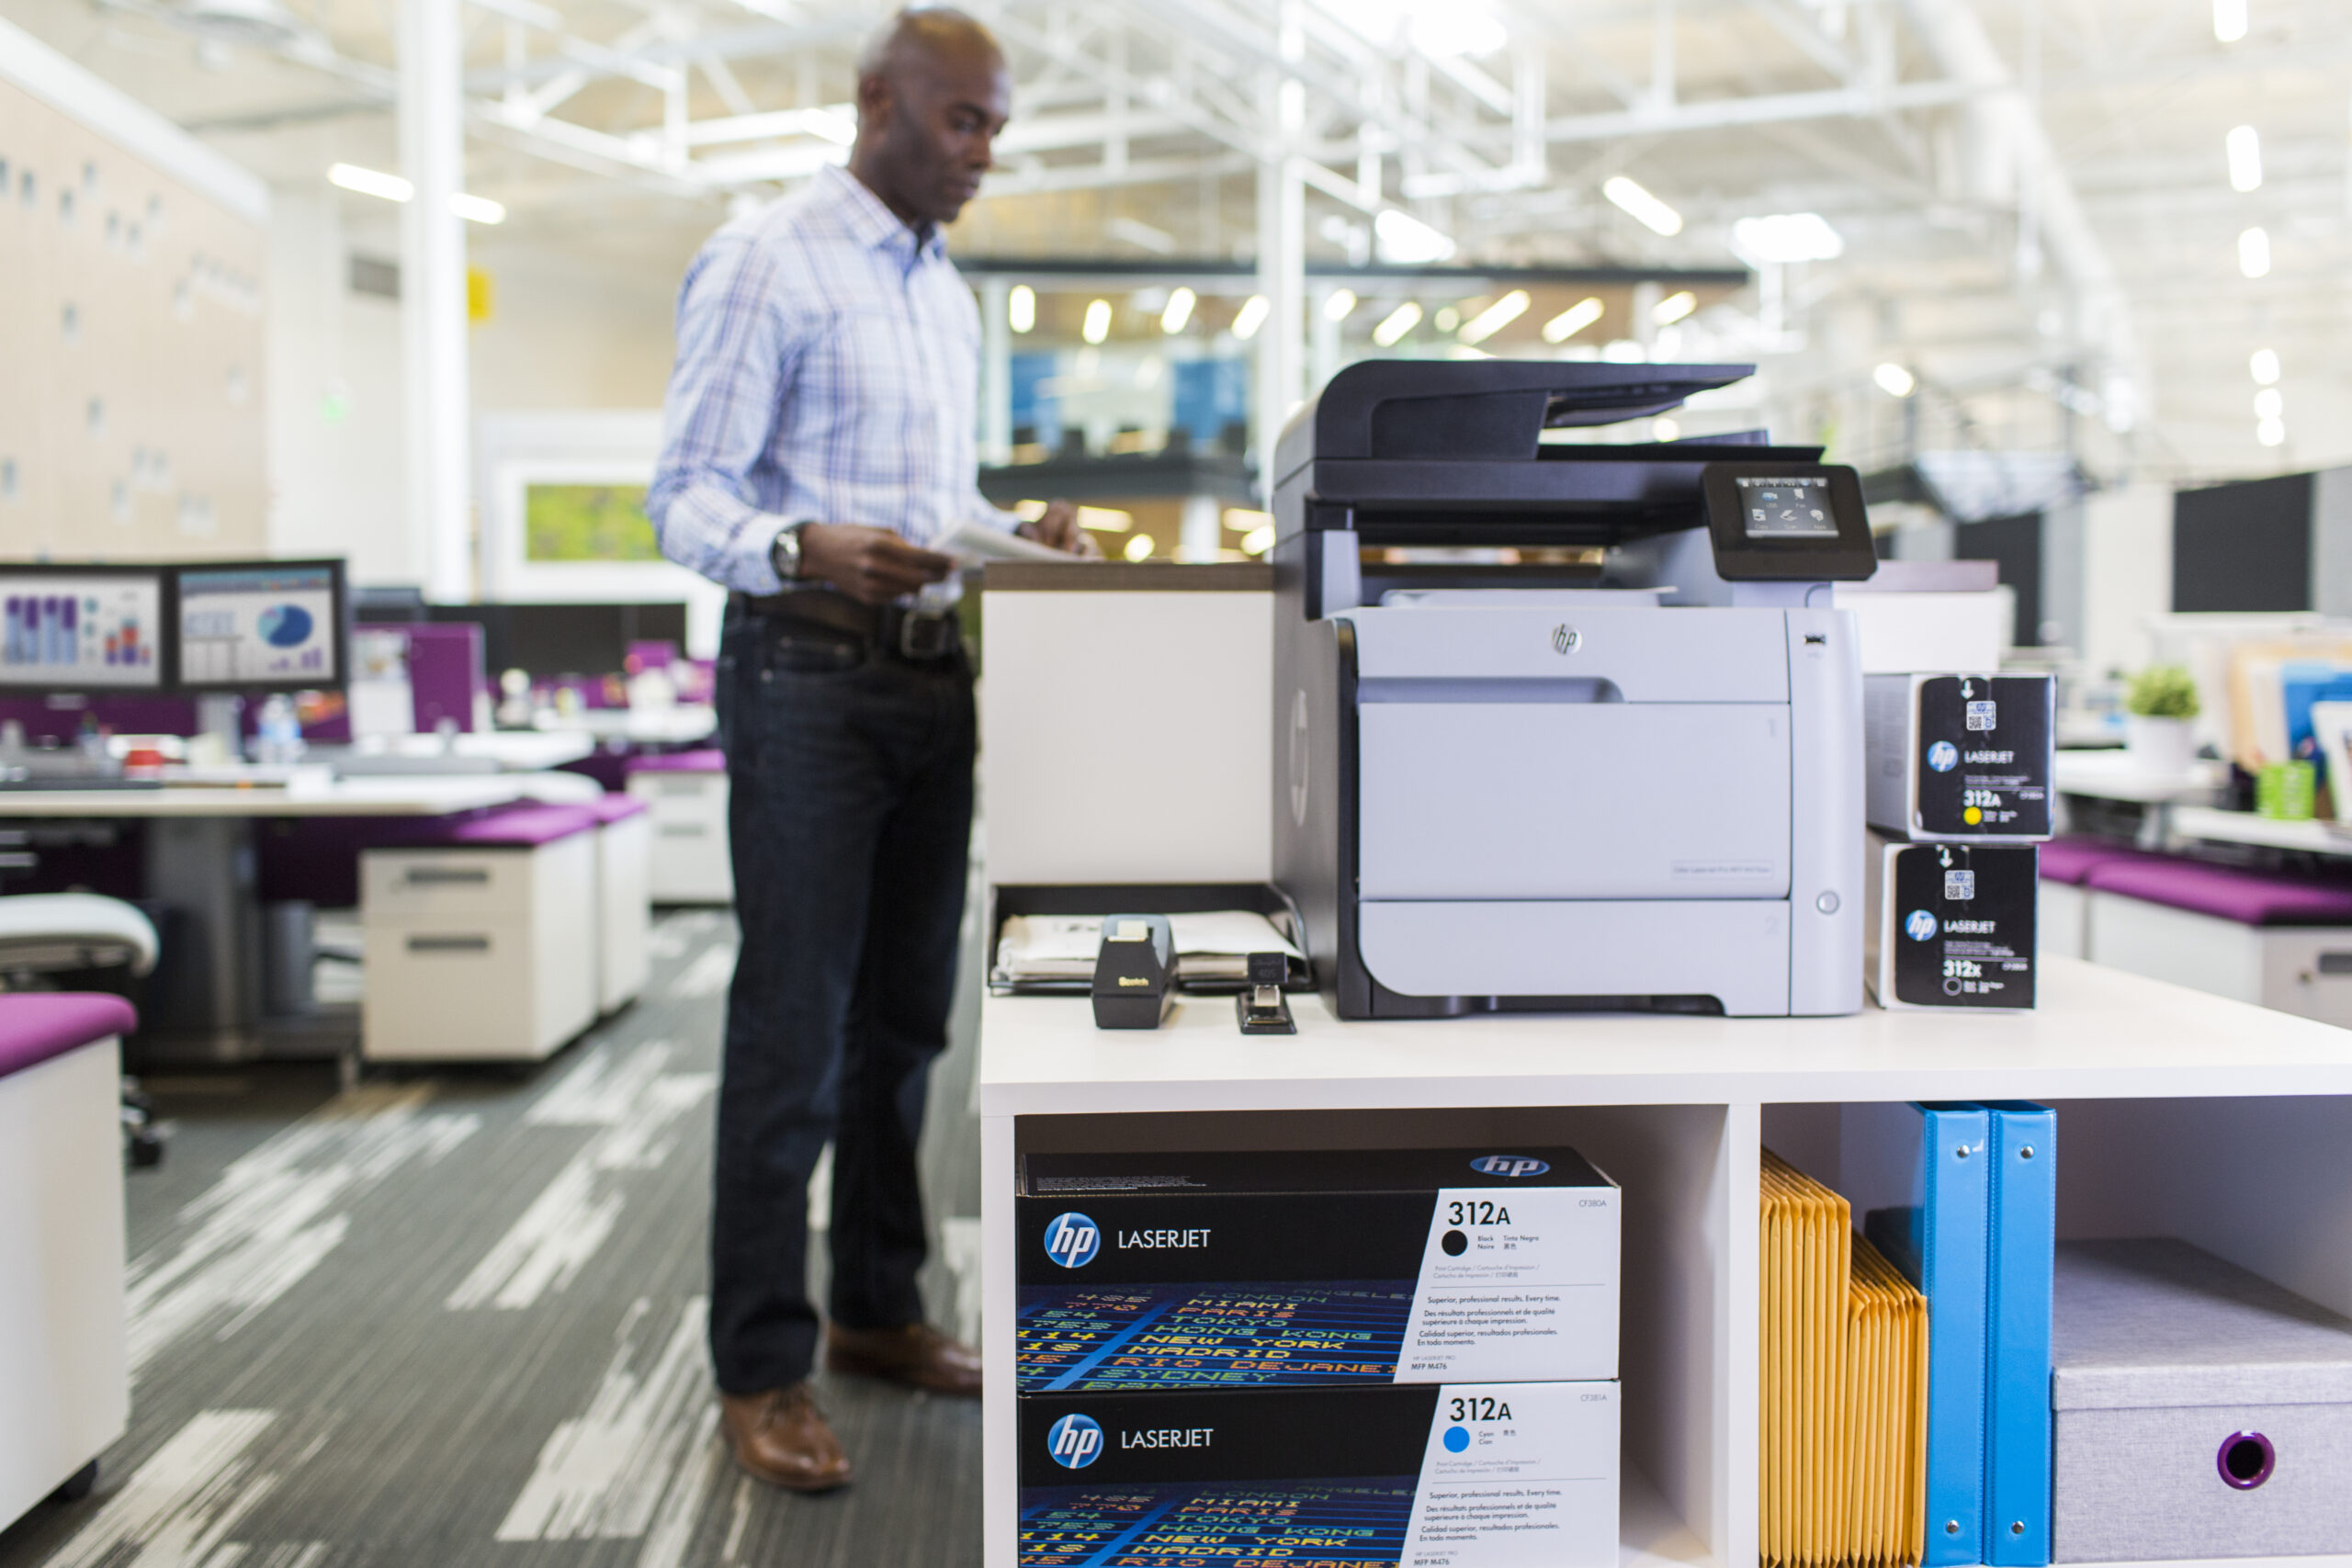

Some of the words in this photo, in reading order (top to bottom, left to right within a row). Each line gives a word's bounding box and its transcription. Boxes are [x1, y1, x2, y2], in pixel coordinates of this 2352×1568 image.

[1555, 623, 1578, 654] hp
[1930, 741, 1956, 772] hp
[1964, 750, 2014, 763] LASERJET
[1963, 790, 2001, 807] 312A
[1908, 909, 1934, 941] hp
[1943, 920, 1996, 933] LASERJET
[1483, 1156, 1539, 1177] hp
[1578, 1200, 1607, 1208] CF380A
[1448, 1201, 1511, 1226] 312A
[1050, 1213, 1095, 1269] hp
[1118, 1229, 1211, 1248] LASERJET
[1520, 1235, 1539, 1243] Negro
[1197, 1290, 1328, 1303] LONDON
[1428, 1296, 1458, 1304] Superior,
[1459, 1295, 1499, 1304] professional
[1501, 1295, 1523, 1303] results.
[1525, 1294, 1544, 1303] Every
[1187, 1299, 1299, 1310] MIAMI
[1177, 1306, 1296, 1318] PARIS
[1440, 1309, 1465, 1317] résultats
[1466, 1308, 1514, 1317] professionnels
[1532, 1307, 1555, 1316] qualité
[1170, 1315, 1289, 1327] TOKYO
[1422, 1318, 1457, 1326] supérieure
[1464, 1317, 1488, 1325] chaque
[1490, 1316, 1527, 1325] impression.
[1153, 1325, 1260, 1337] HONG
[1281, 1329, 1373, 1340] KONG
[1446, 1330, 1476, 1338] superior,
[1512, 1328, 1558, 1337] profesionales.
[1139, 1335, 1224, 1347] NEW
[1251, 1338, 1346, 1349] YORK
[1126, 1346, 1291, 1359] MADRID
[1113, 1357, 1202, 1368] RIO
[1097, 1369, 1277, 1382] SYDNEY
[1449, 1397, 1512, 1422] 312A
[1122, 1428, 1214, 1449] LASERJET
[1478, 1430, 1494, 1438] Cyan
[1054, 1414, 1099, 1469] hp
[1201, 1489, 1330, 1500] LONDON
[1430, 1492, 1460, 1500] Superior,
[1461, 1490, 1500, 1499] professional
[1502, 1489, 1524, 1497] results.
[1526, 1489, 1544, 1497] Every
[1191, 1497, 1301, 1508] MIAMI
[1468, 1503, 1516, 1512] professionnels
[1534, 1502, 1556, 1511] qualité
[1180, 1506, 1299, 1516] PARIS
[1424, 1514, 1459, 1522] supérieure
[1466, 1512, 1490, 1521] chaque
[1492, 1511, 1529, 1520] impression.
[1173, 1515, 1292, 1525] TOKYO
[1157, 1524, 1261, 1534] HONG
[1283, 1527, 1374, 1537] KONG
[1449, 1525, 1478, 1533] superior,
[1514, 1523, 1560, 1532] profesionales.
[1144, 1534, 1227, 1544] NEW
[1254, 1536, 1348, 1547] YORK
[1131, 1545, 1295, 1557] MADRID
[1116, 1556, 1206, 1567] RIO
